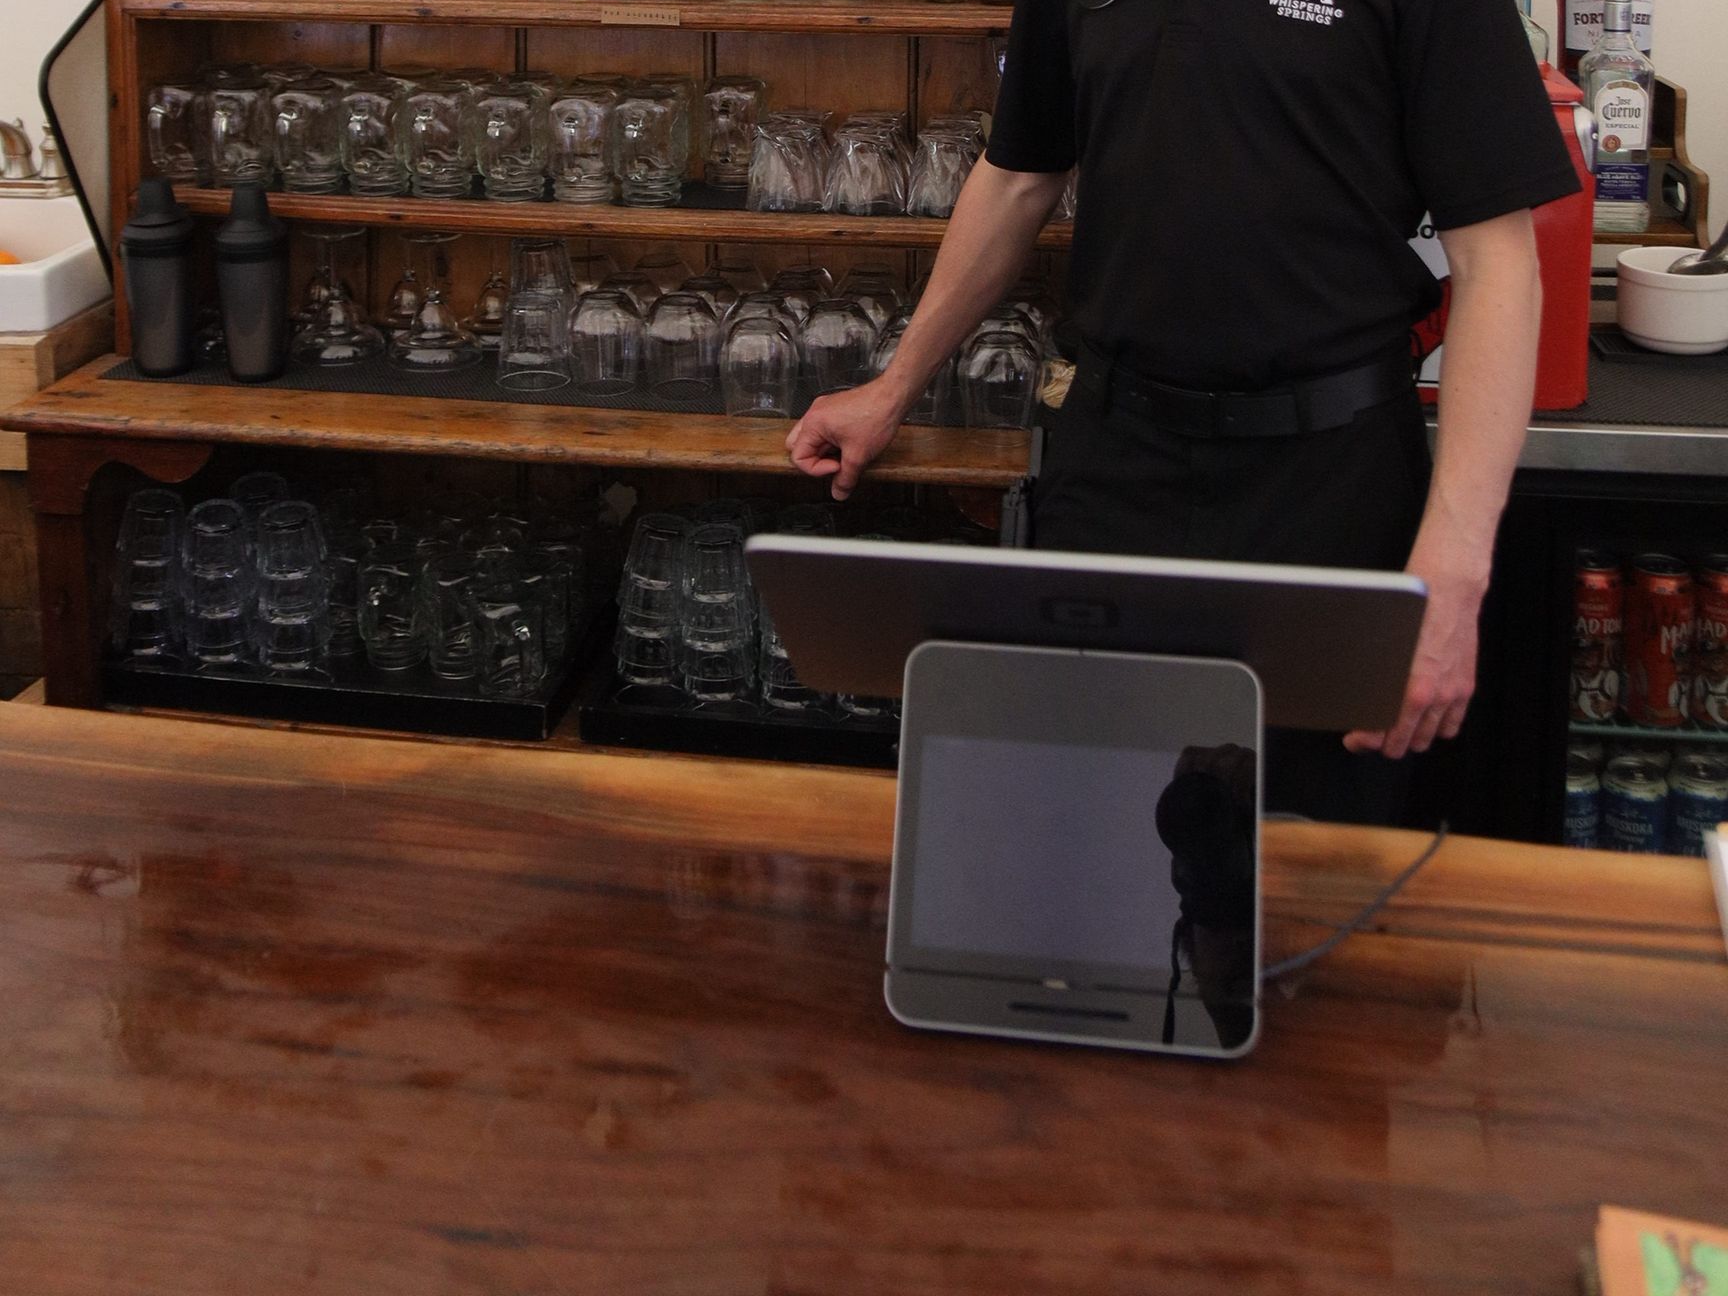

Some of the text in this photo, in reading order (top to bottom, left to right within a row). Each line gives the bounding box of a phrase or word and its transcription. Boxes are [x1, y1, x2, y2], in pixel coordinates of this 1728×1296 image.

[1276, 6, 1332, 26] SPRINGS
[1573, 12, 1605, 26] FORT
[1602, 102, 1642, 121] Cuervo
